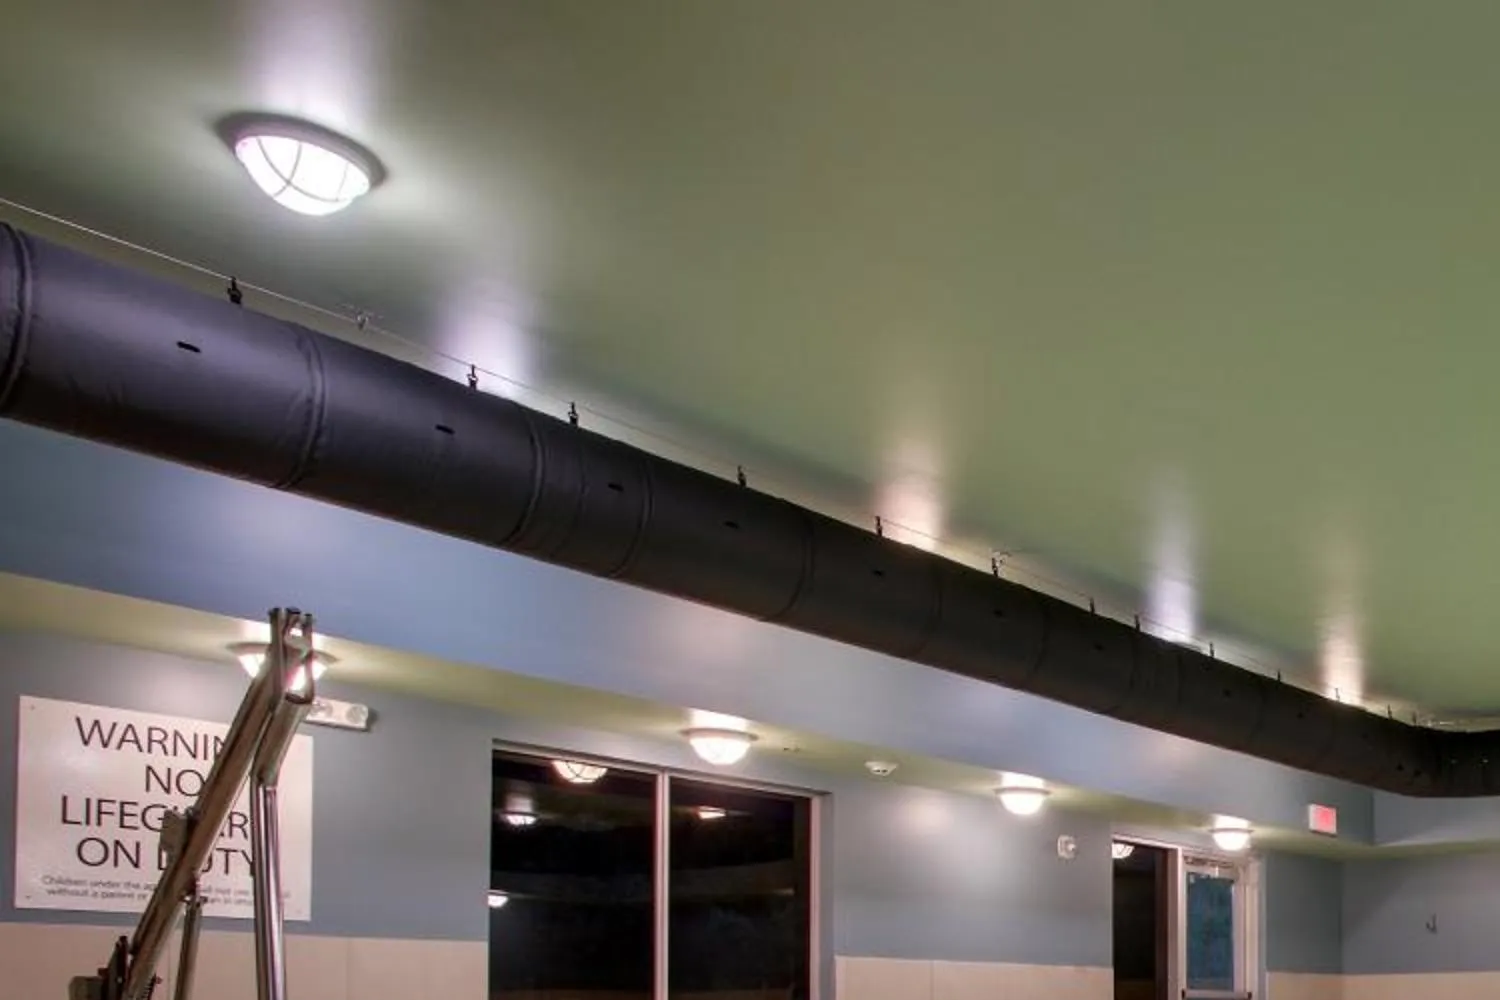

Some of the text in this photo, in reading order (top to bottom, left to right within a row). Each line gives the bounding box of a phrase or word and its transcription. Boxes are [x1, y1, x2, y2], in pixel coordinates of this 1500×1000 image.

[75, 716, 230, 761] WARNIN
[145, 765, 206, 797] NO
[77, 837, 141, 869] ON
